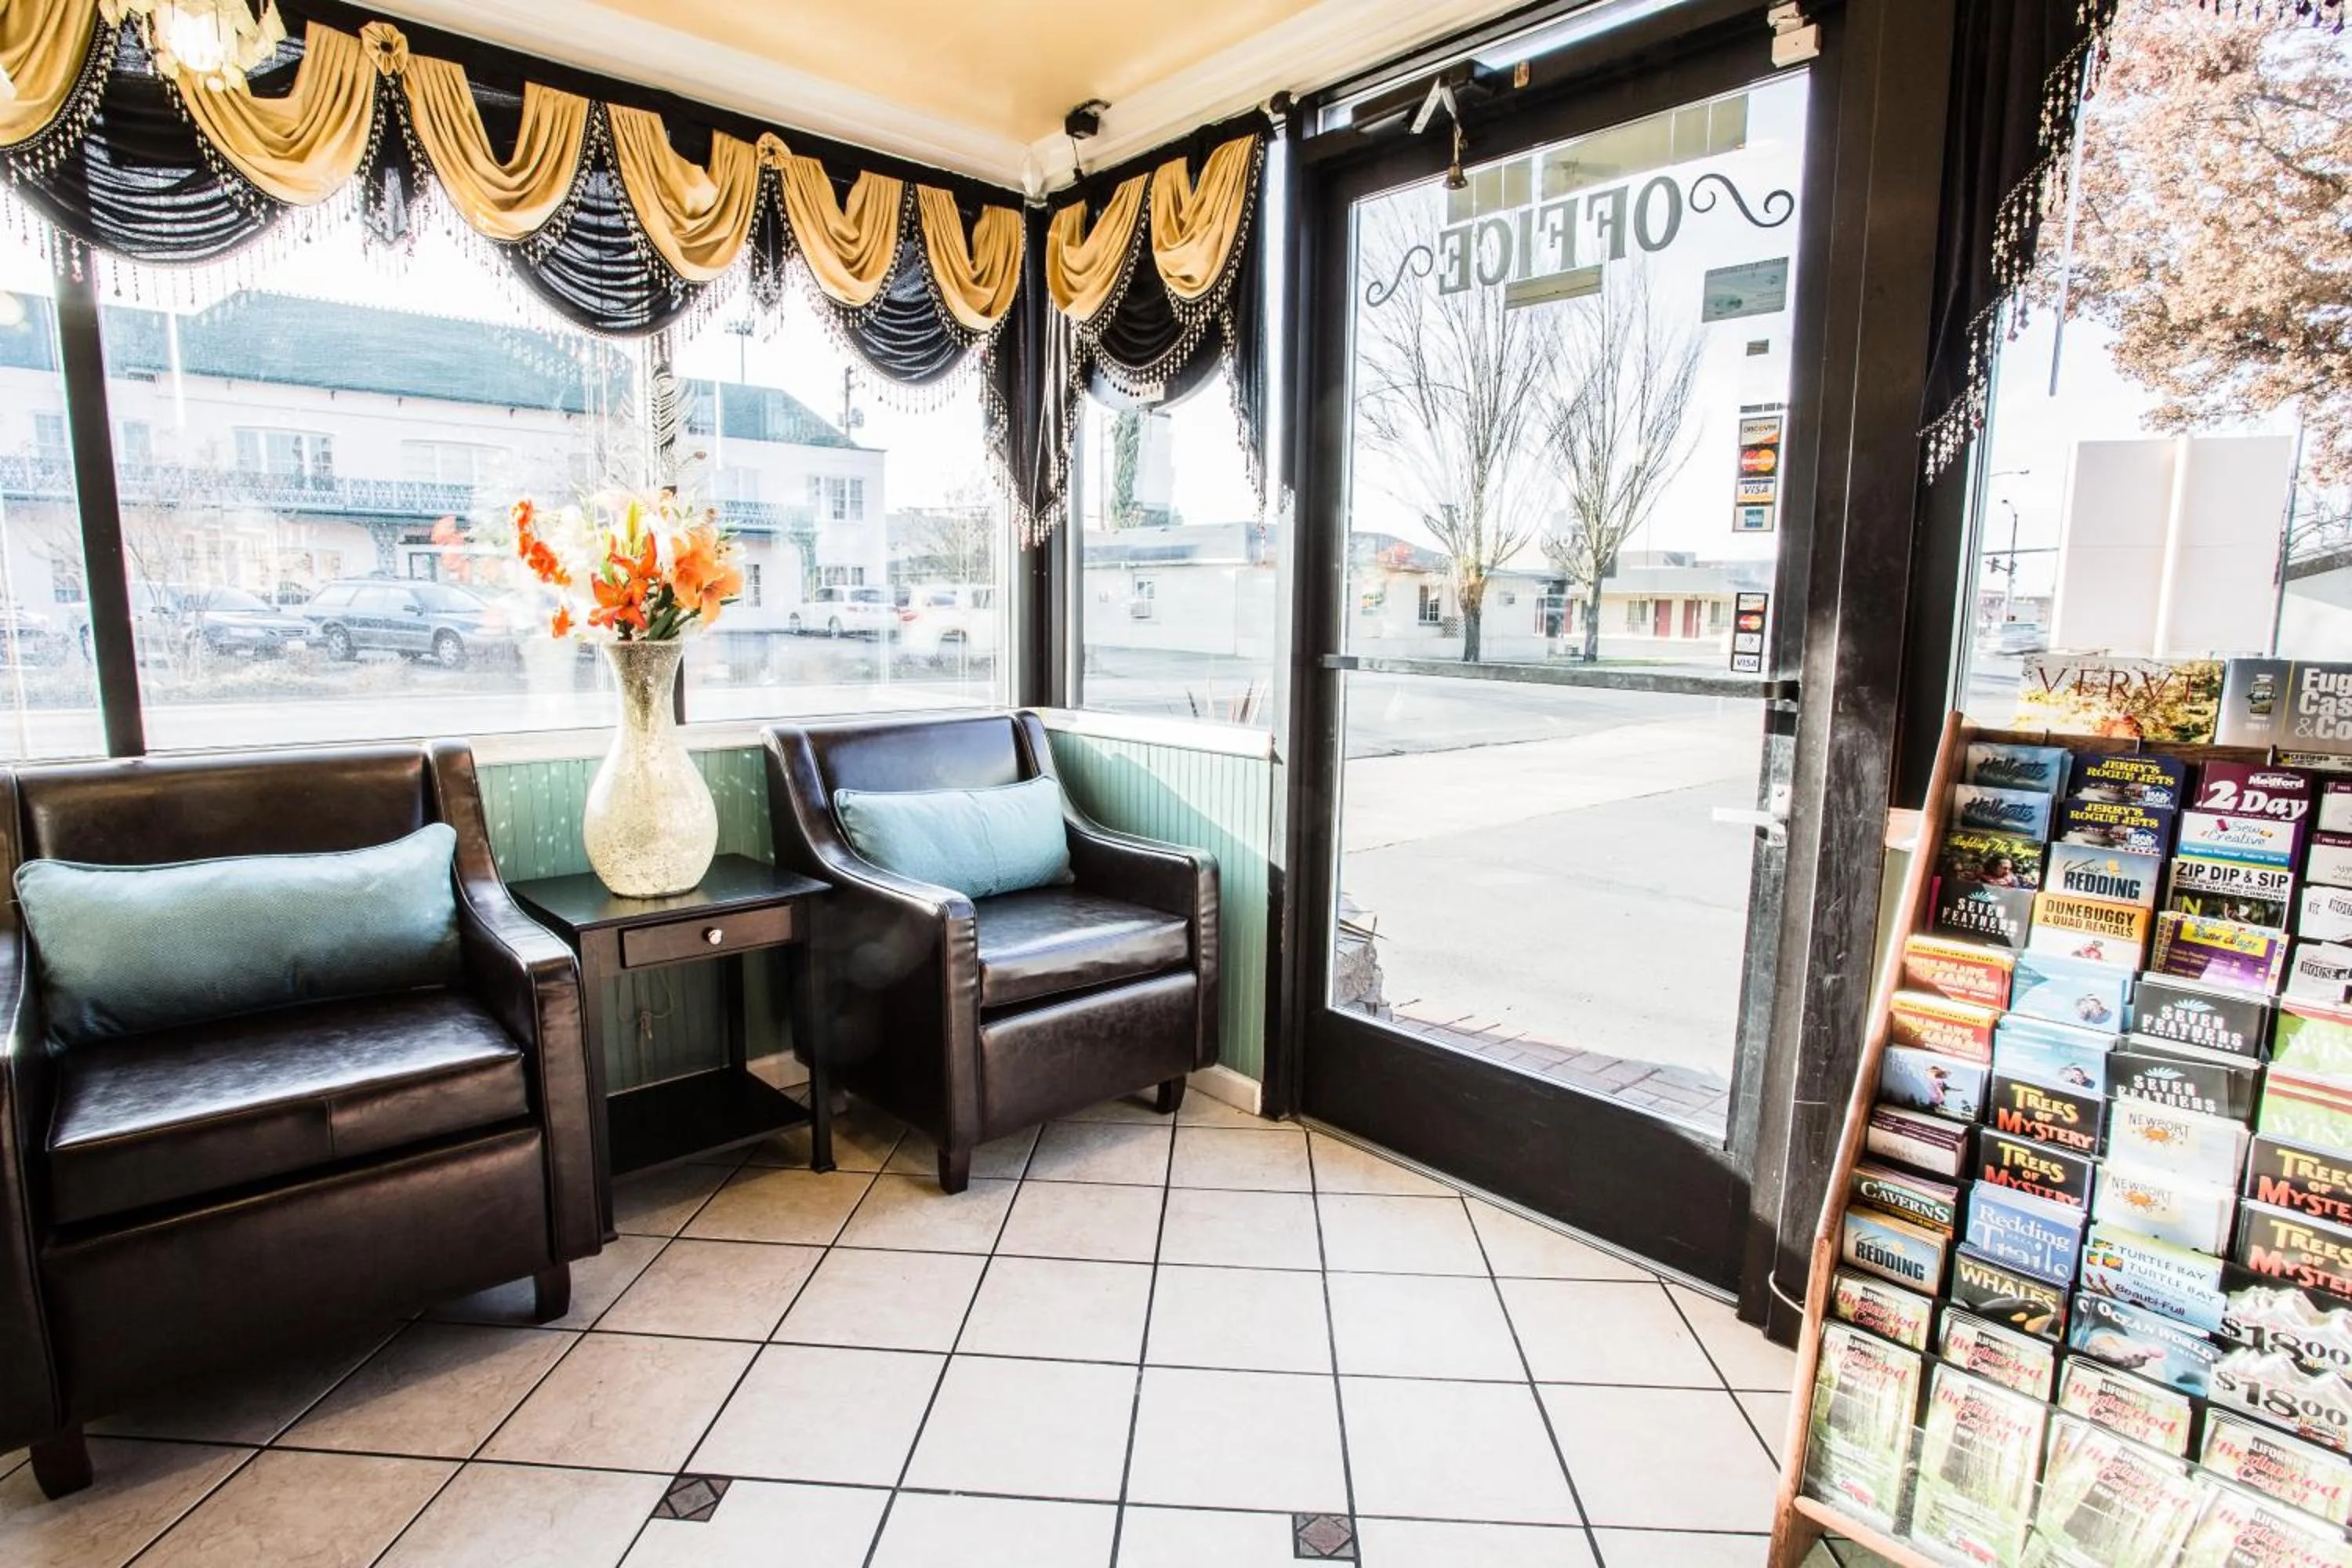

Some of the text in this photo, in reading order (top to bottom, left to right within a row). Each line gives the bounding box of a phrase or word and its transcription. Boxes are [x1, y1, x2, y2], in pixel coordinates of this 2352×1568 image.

[1744, 485, 1769, 495] VISA
[1737, 659, 1757, 667] VISA
[2085, 766, 2176, 786] ROGUE JETS
[2101, 759, 2162, 775] JERRY'S
[2085, 802, 2145, 818] JERRY'S
[2201, 779, 2310, 822] 2 Day
[2069, 810, 2160, 829] ROGUE JETS
[2063, 871, 2142, 901] REDDING
[2176, 862, 2288, 888] ZIP DIP & SIP
[1941, 906, 2020, 934] FEATHERS
[1957, 897, 2008, 919] SEVEN
[2044, 898, 2136, 927] DUNEBUGGY
[2042, 915, 2134, 938] & QUAD RENTALS
[2299, 960, 2337, 980] HOUSE
[2141, 1014, 2245, 1047] FEATHERS
[2161, 1004, 2225, 1029] SEVEN
[2116, 1083, 2217, 1113] FEATHERS
[2132, 1074, 2195, 1097] SEVEN
[2009, 1083, 2079, 1124] TREES
[2034, 1111, 2054, 1123] OF
[1997, 1107, 2096, 1149] MYSTERY
[2128, 1112, 2191, 1138] NEWPORT
[1998, 1142, 2067, 1183] TREES
[2022, 1169, 2041, 1181] OF
[1984, 1164, 2082, 1207] MYSTERY
[2111, 1176, 2173, 1205] NEWPORT
[2307, 1181, 2333, 1194] OF
[1860, 1181, 1951, 1224] CAVERNS
[1980, 1203, 2071, 1253] Redding
[1854, 1241, 1926, 1282] REDDING
[2118, 1245, 2208, 1280] TURTLE BAY
[2300, 1252, 2326, 1266] OF
[1960, 1263, 2057, 1314] WHALES
[2129, 1261, 2182, 1289] TURTLE
[2187, 1286, 2219, 1304] BAY
[2096, 1301, 2155, 1335] OCEAN
[2157, 1327, 2214, 1361] WORLD
